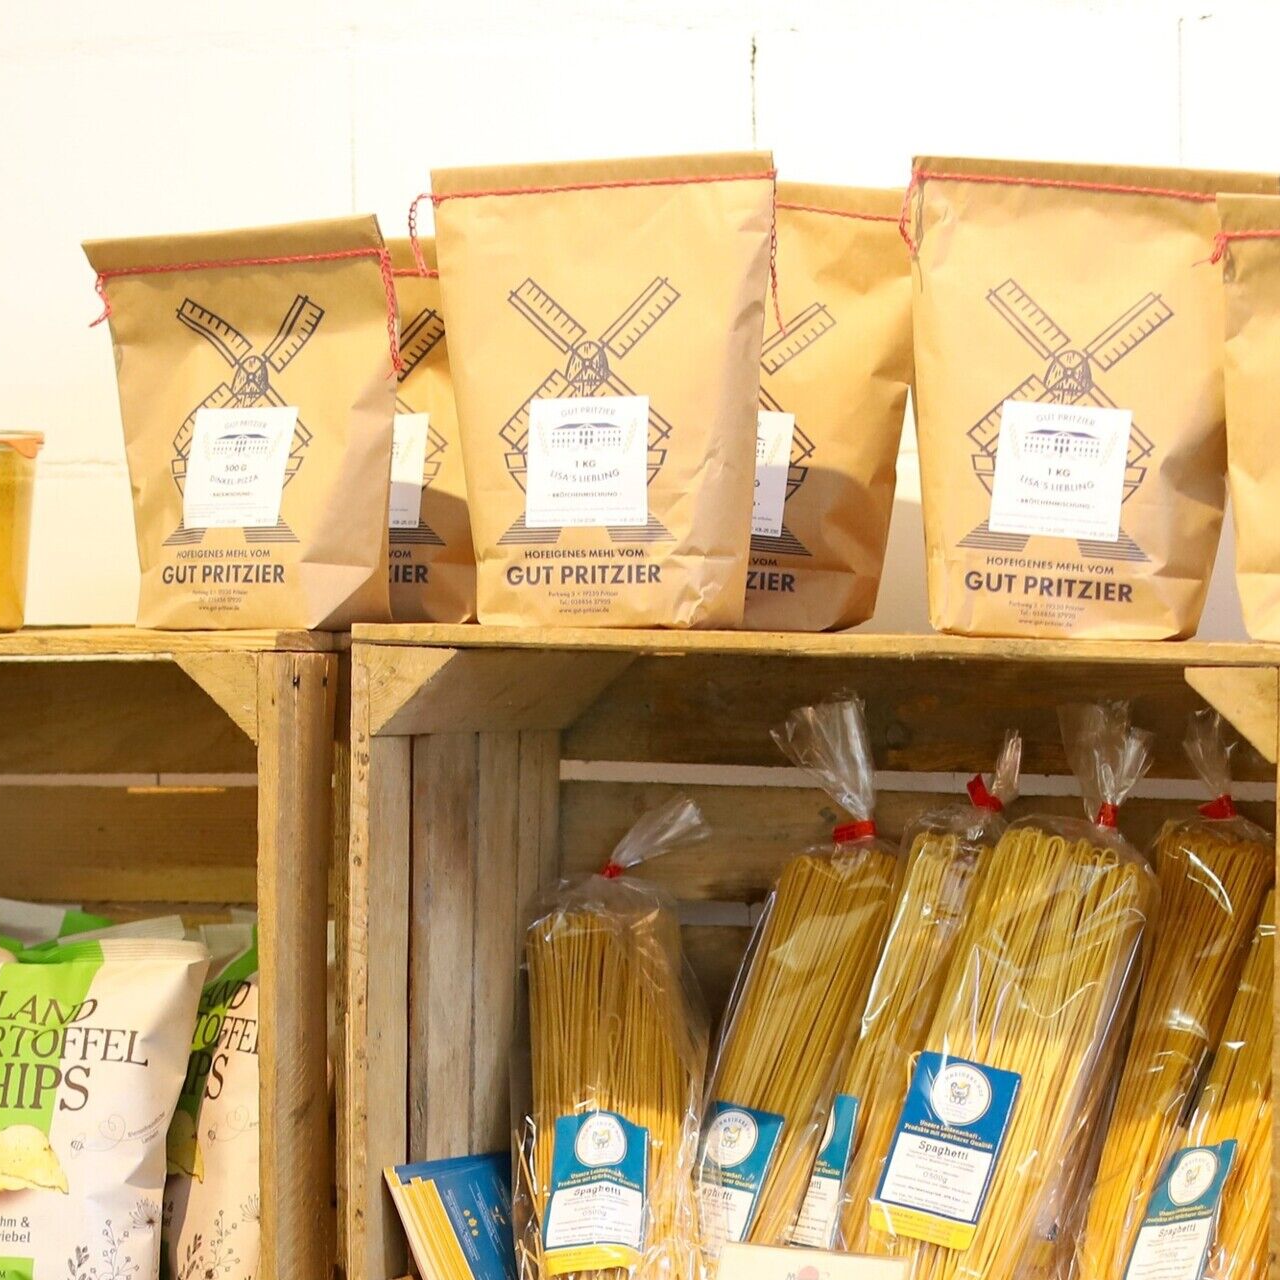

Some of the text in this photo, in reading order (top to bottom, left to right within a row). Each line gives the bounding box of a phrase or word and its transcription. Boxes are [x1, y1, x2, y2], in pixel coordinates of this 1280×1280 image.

[579, 469, 620, 483] LIEBLING
[1051, 481, 1094, 492] LIEBLING
[176, 549, 270, 559] HOFEIGENES MEHL VOM
[524, 549, 644, 560] HOFEIGENES MEHL VOM
[162, 564, 285, 584] GUT PRITZIER
[986, 557, 1114, 575] HOFEIGENES MEHL VOM
[507, 564, 662, 586] GUT PRITZIER
[965, 571, 1132, 603] GUT PRITZIER
[905, 1123, 993, 1149] Produkte mit spürbarer Qualität
[920, 1120, 979, 1140] Unsere Leidenschaft
[918, 1140, 968, 1161] Spaghetti
[574, 1185, 621, 1197] Spaghetti
[21, 1216, 30, 1228] &
[1158, 1224, 1196, 1239] Spaghetti
